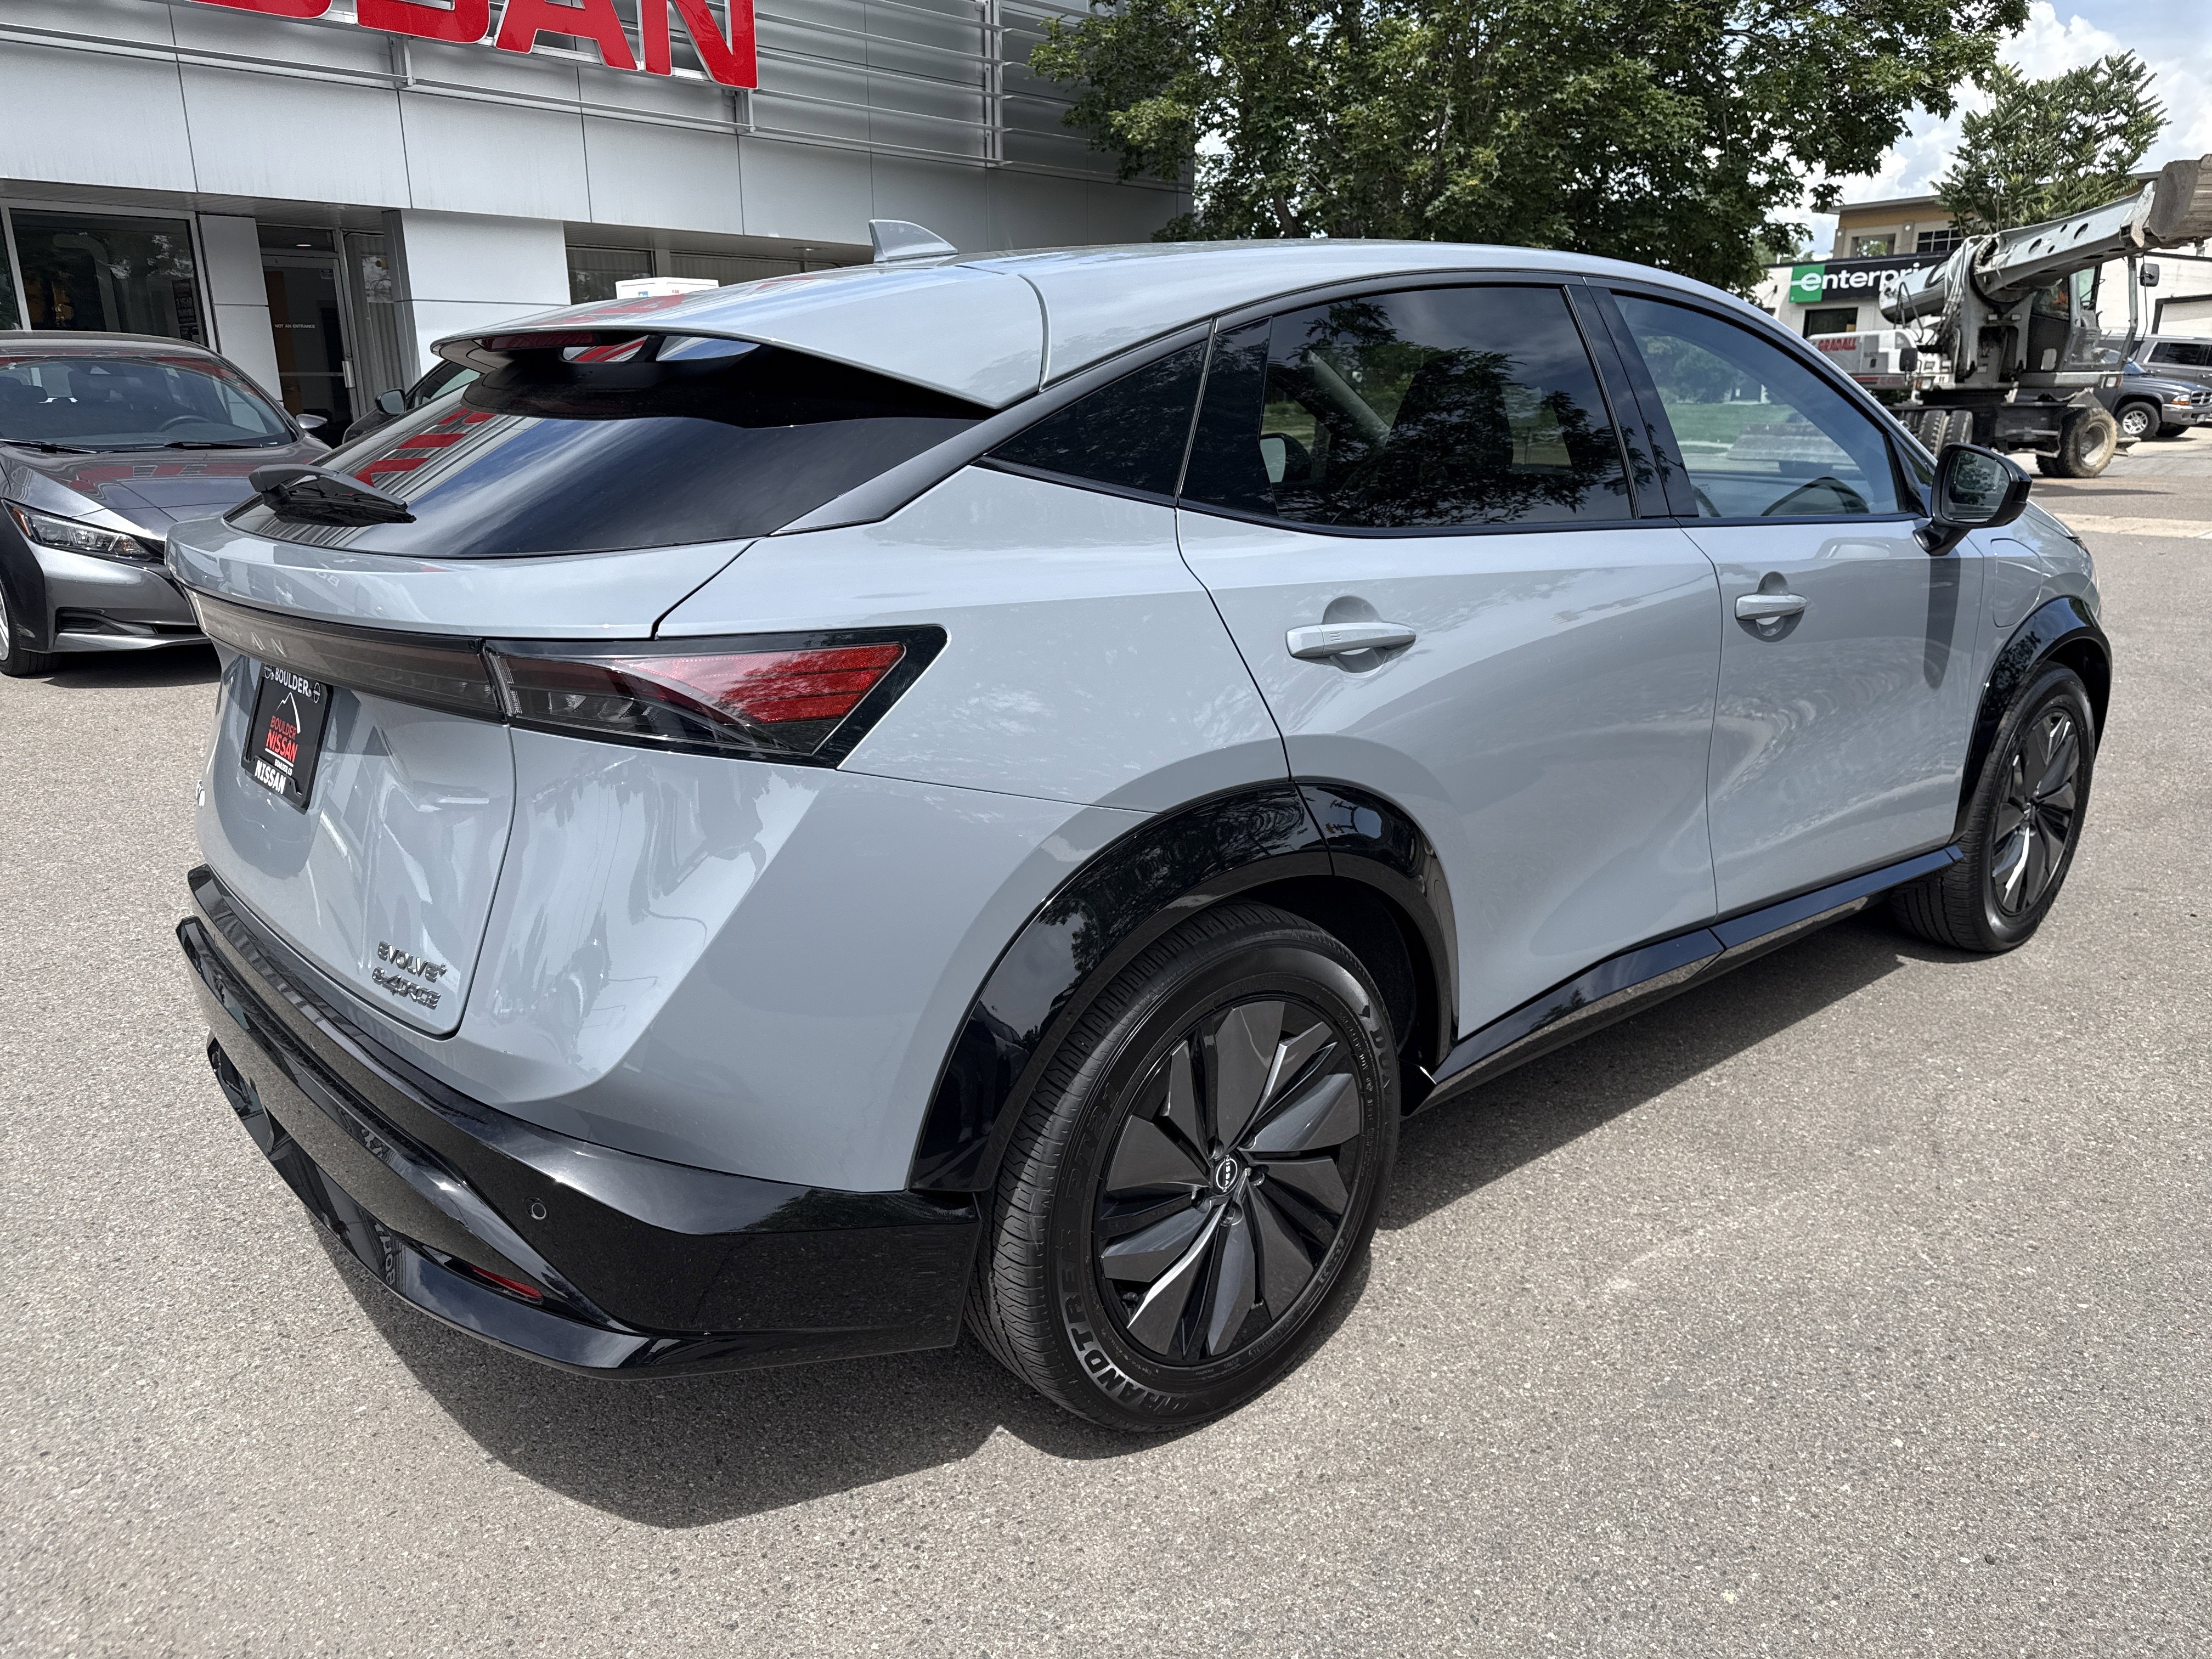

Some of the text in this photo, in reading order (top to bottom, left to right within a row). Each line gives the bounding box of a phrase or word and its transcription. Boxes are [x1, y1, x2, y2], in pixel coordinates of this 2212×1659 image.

[1818, 337, 1857, 352] GRADALL
[275, 668, 309, 696] BOULDER
[270, 715, 297, 740] BOULDER
[266, 729, 298, 763] NISSAN
[255, 760, 286, 794] NISSAN
[1222, 1154, 1231, 1193] NISSAN
